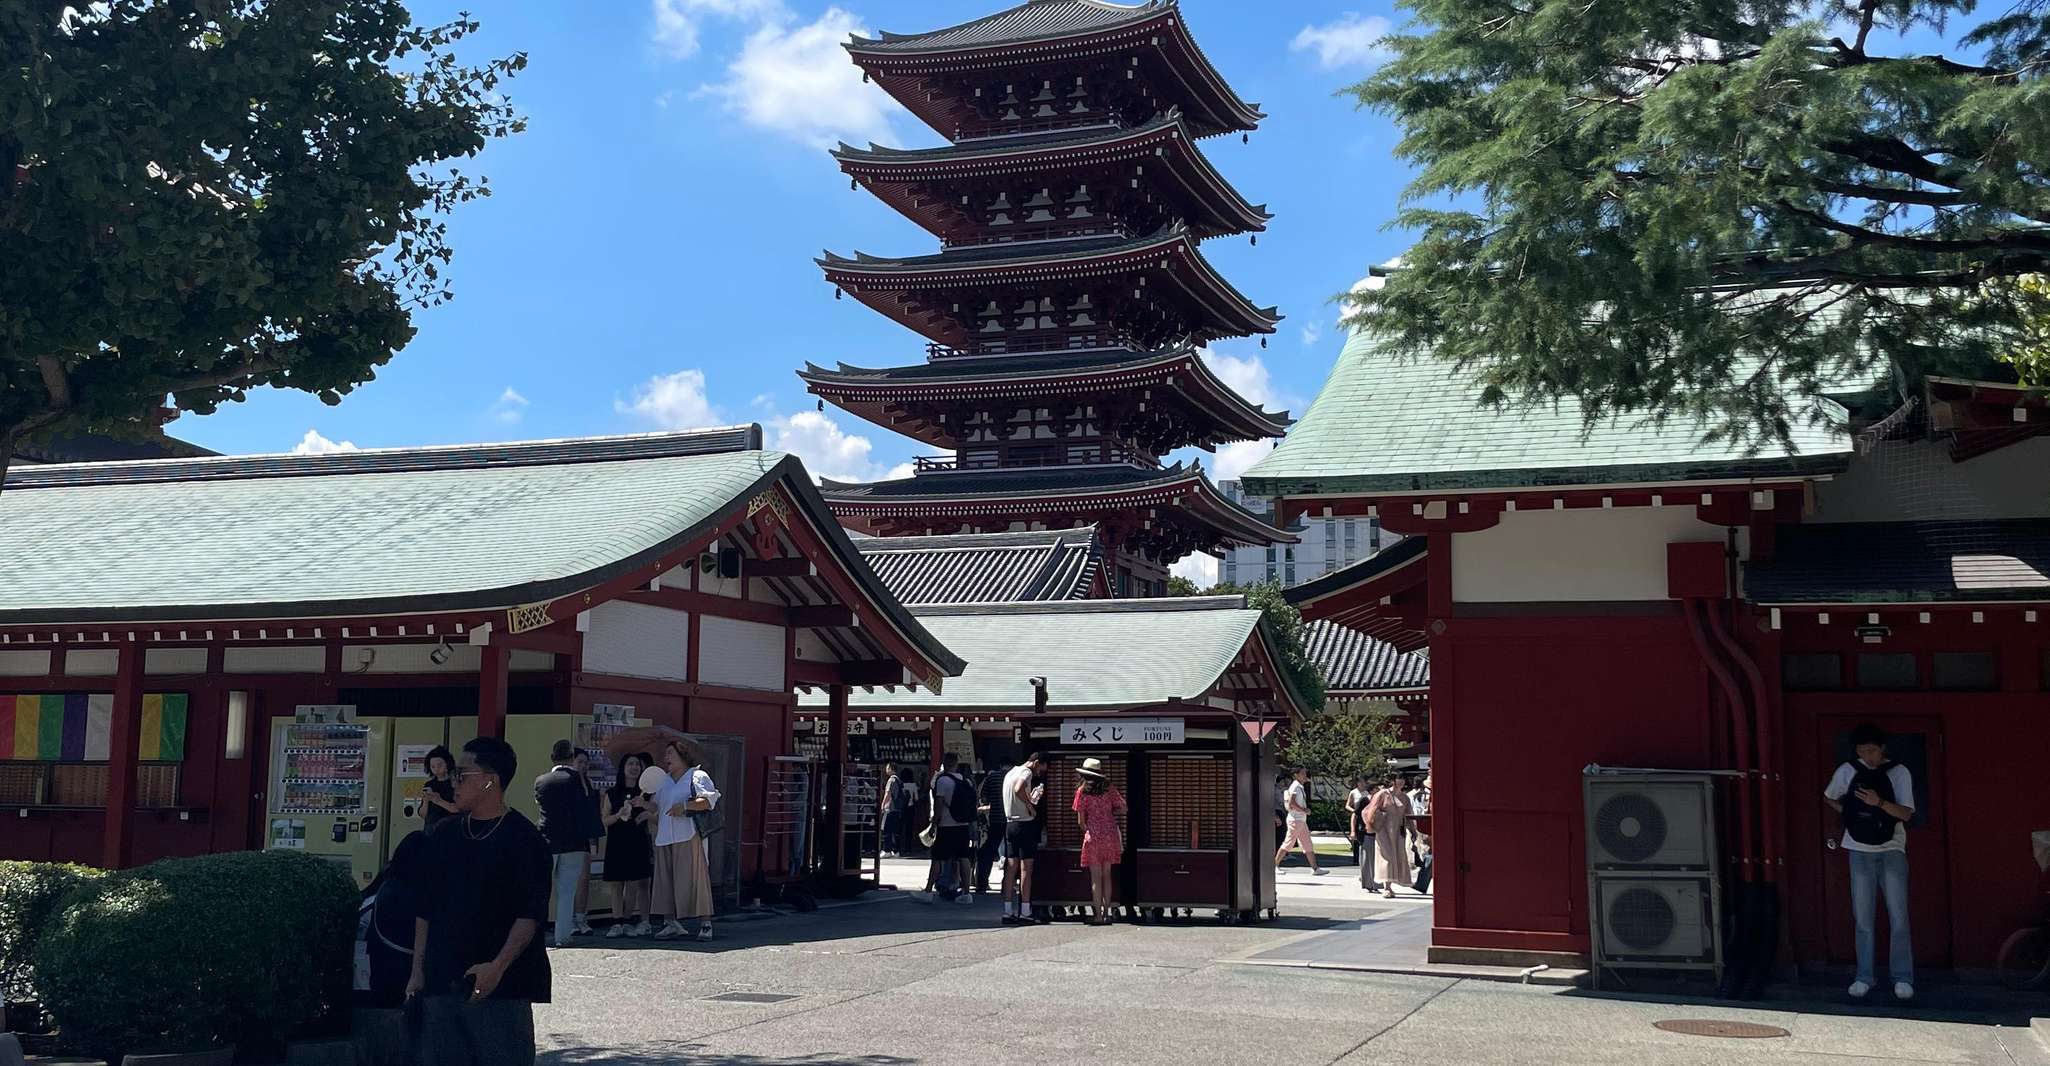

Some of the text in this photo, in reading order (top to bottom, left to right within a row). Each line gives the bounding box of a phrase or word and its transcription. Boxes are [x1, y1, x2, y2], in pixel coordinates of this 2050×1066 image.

[1072, 726, 1123, 742] みくじ
[1144, 731, 1172, 741] 100円
